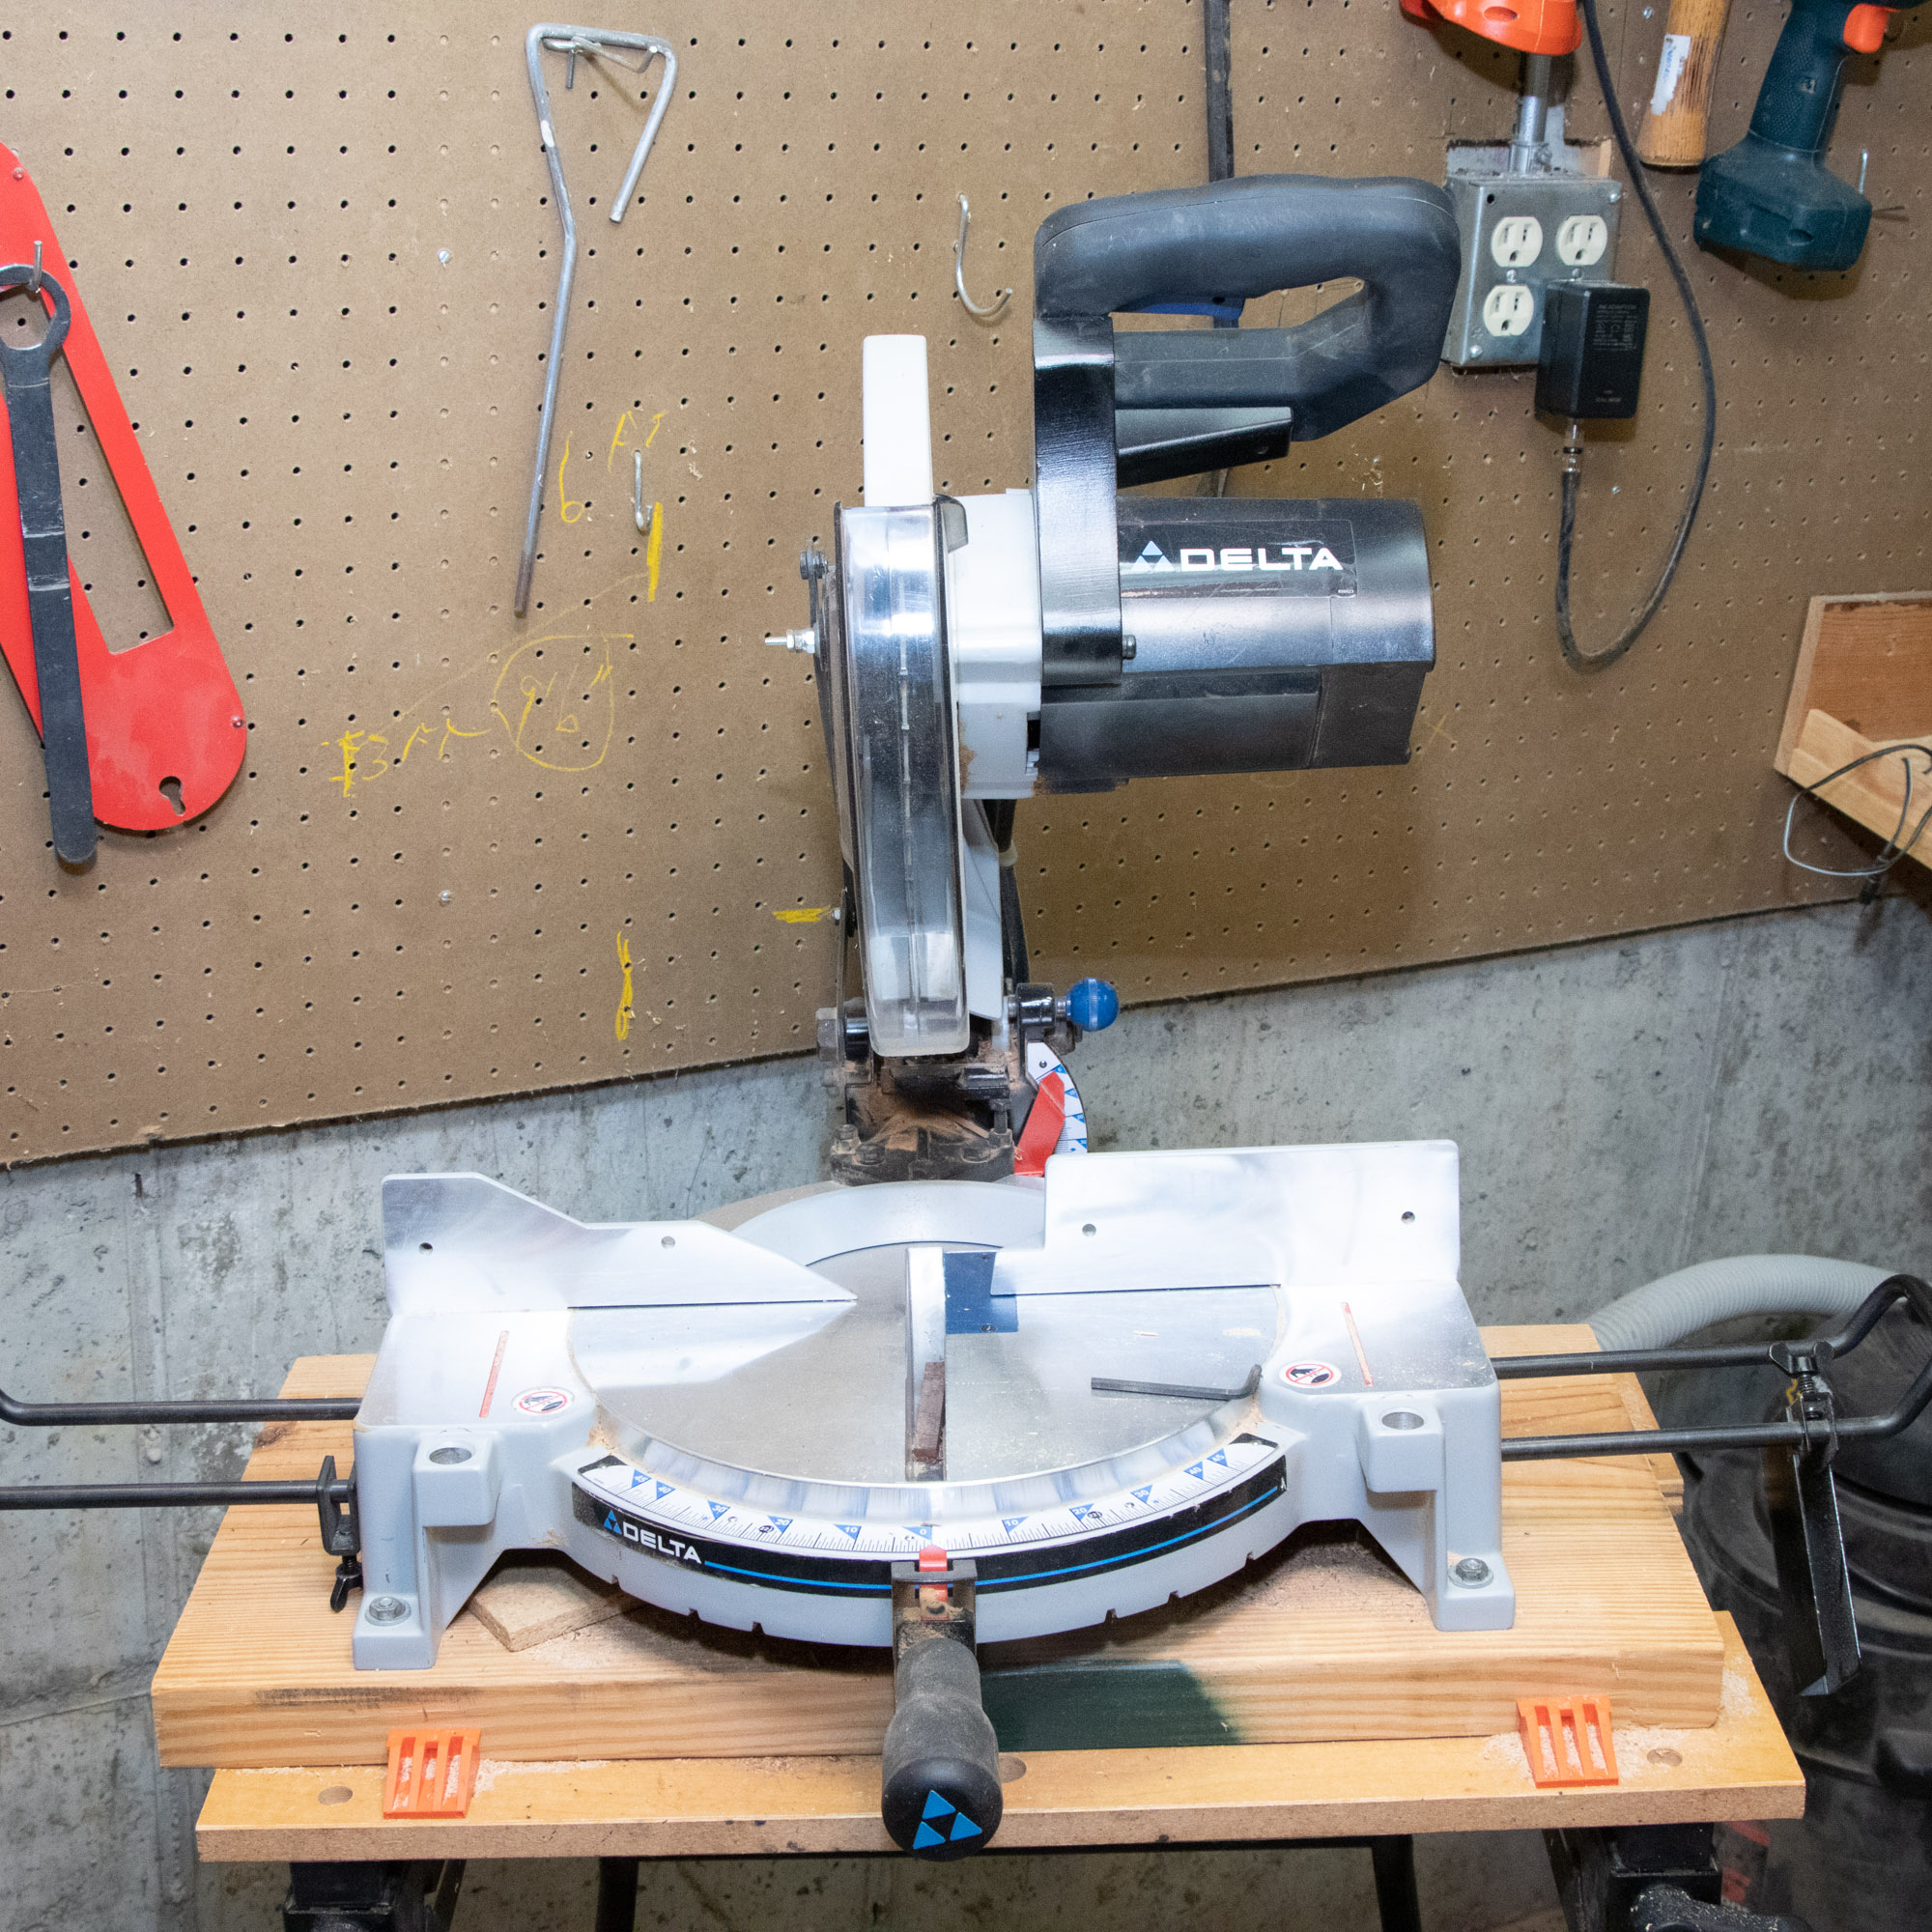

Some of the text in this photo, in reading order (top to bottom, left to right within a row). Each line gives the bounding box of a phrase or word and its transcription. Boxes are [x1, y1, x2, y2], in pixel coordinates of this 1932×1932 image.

[1179, 547, 1344, 572] DELTA
[634, 1474, 649, 1483] 45
[658, 1486, 672, 1494] 40
[711, 1503, 727, 1513] 30
[775, 1518, 790, 1526] 20
[1071, 1506, 1088, 1515] 20
[1134, 1489, 1150, 1497] 30
[1189, 1466, 1203, 1476] 40
[1211, 1454, 1225, 1463] 45
[622, 1520, 702, 1564] DELTA
